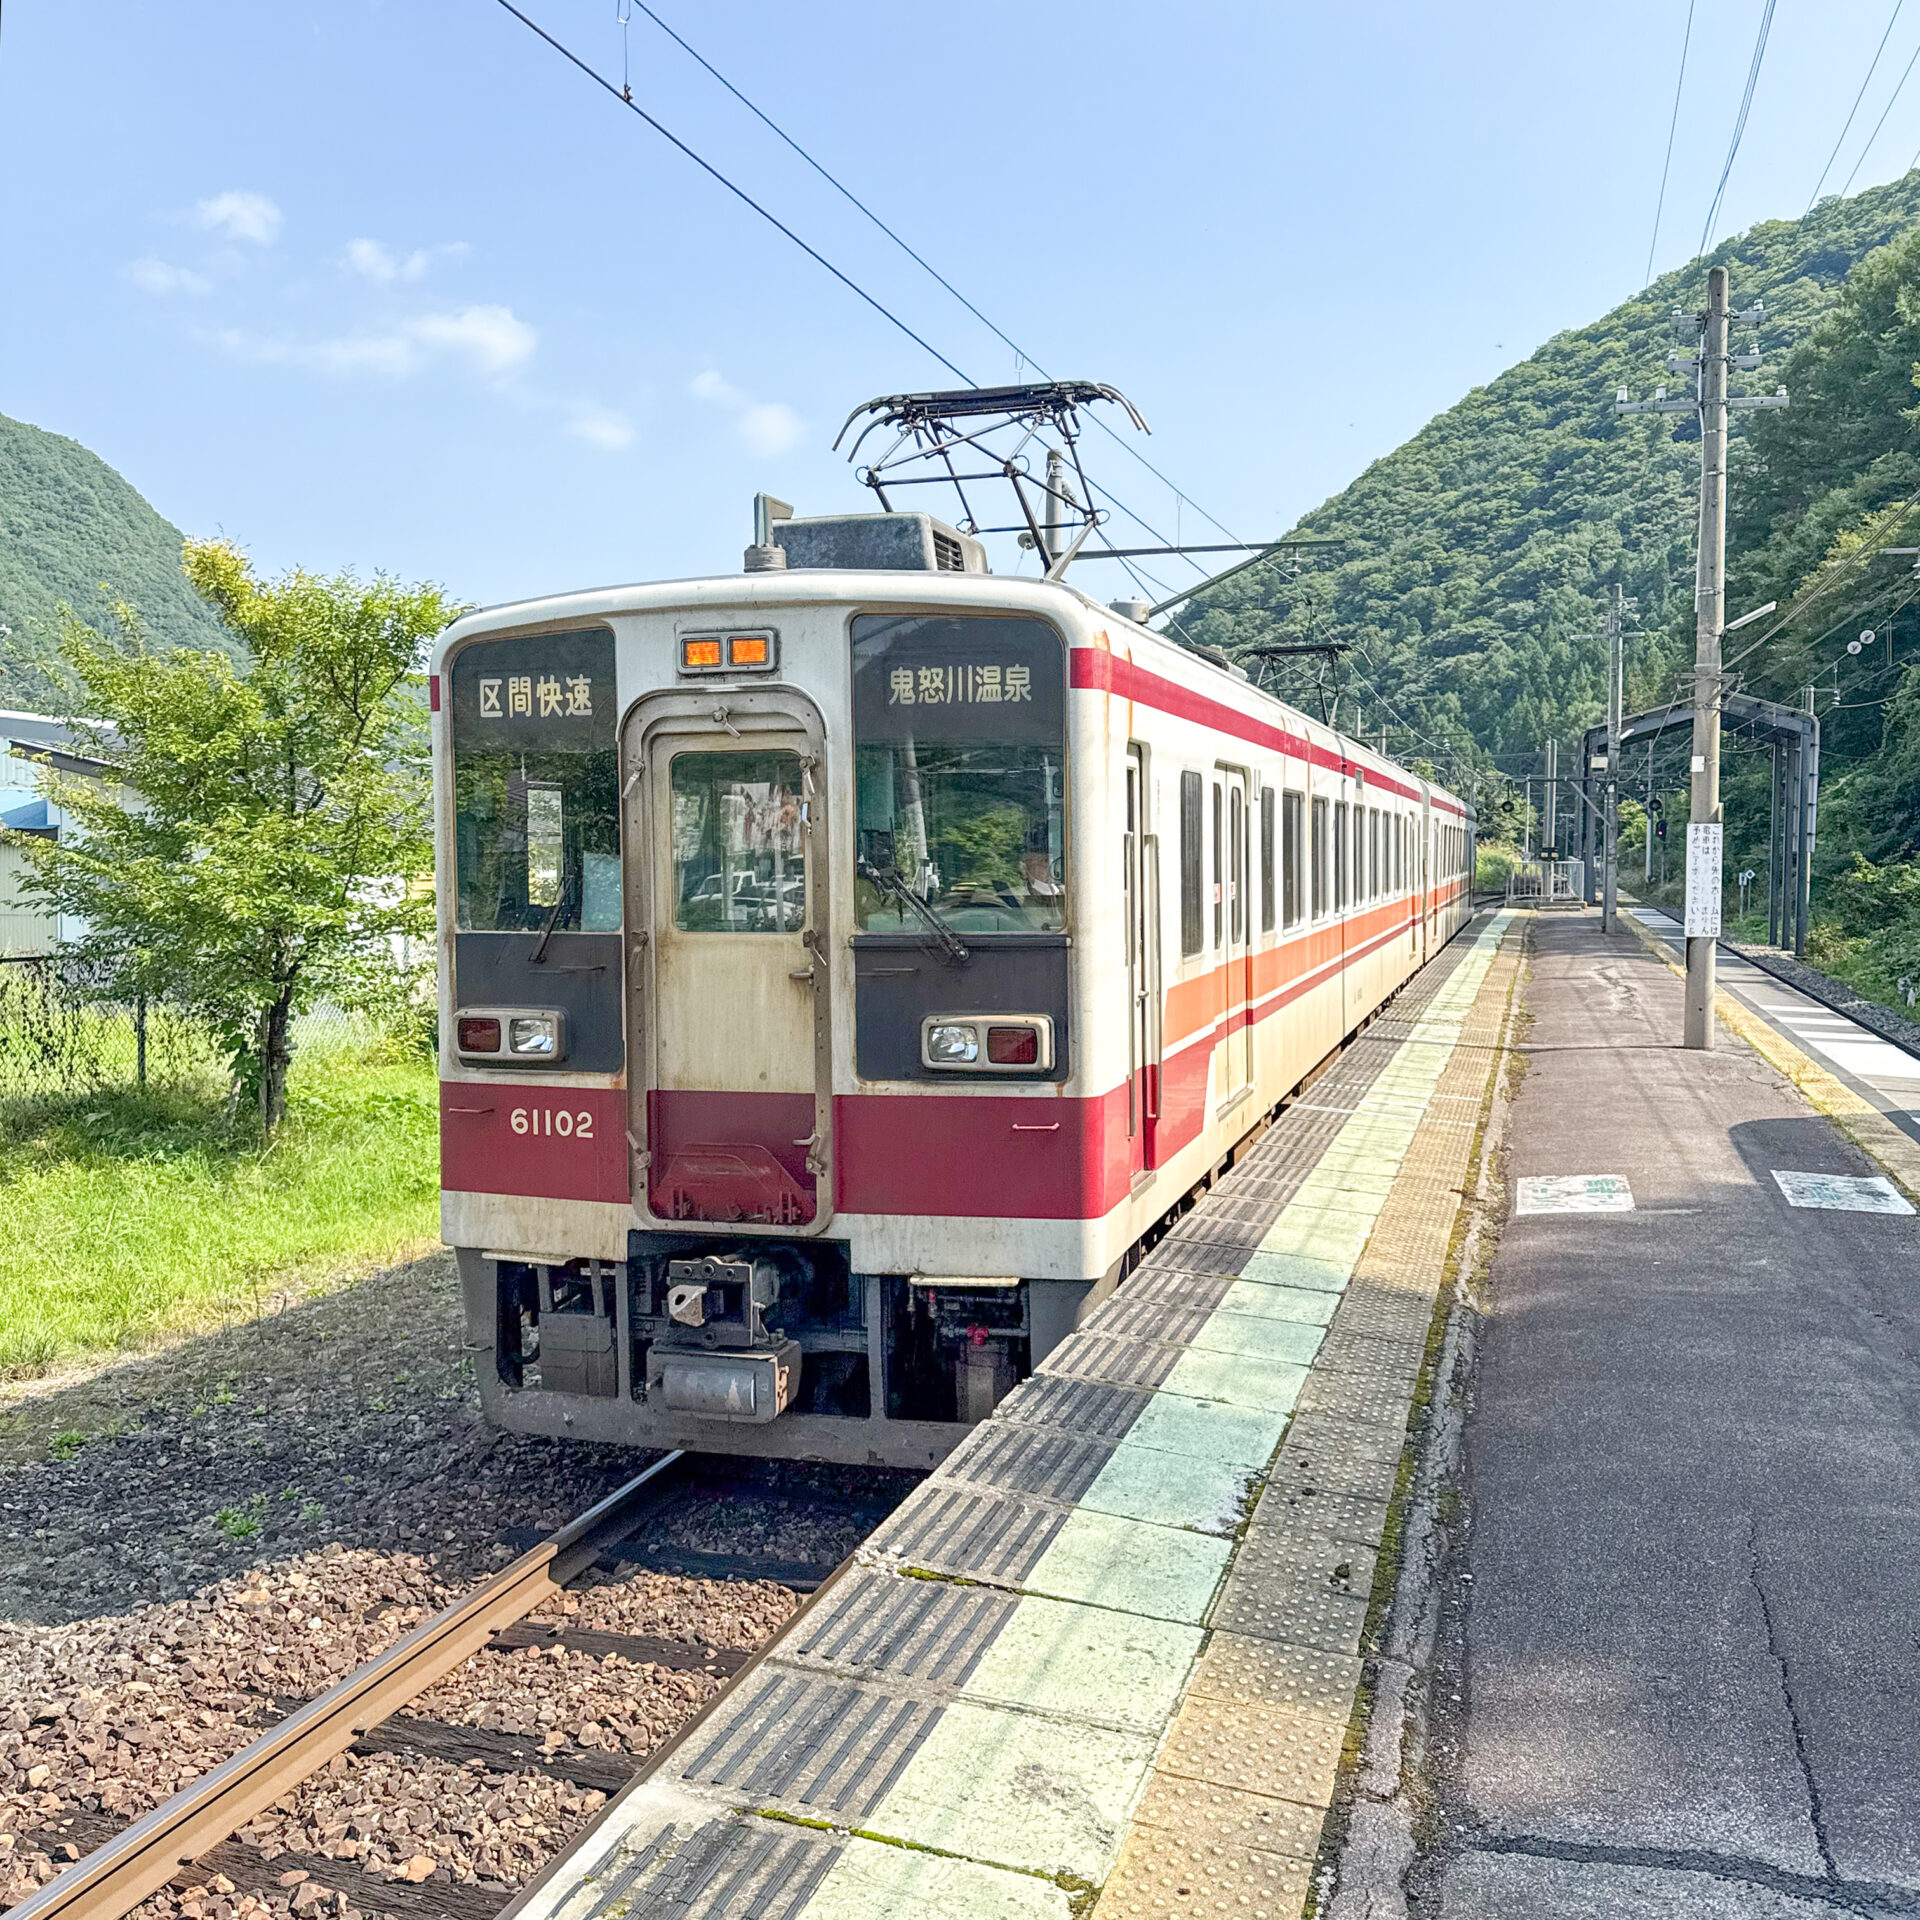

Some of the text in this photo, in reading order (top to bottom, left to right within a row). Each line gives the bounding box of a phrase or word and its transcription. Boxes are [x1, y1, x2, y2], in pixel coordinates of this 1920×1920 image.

[479, 674, 593, 718] 区間快速
[888, 664, 1032, 705] 鬼怒川温泉
[510, 1107, 594, 1139] 61102
